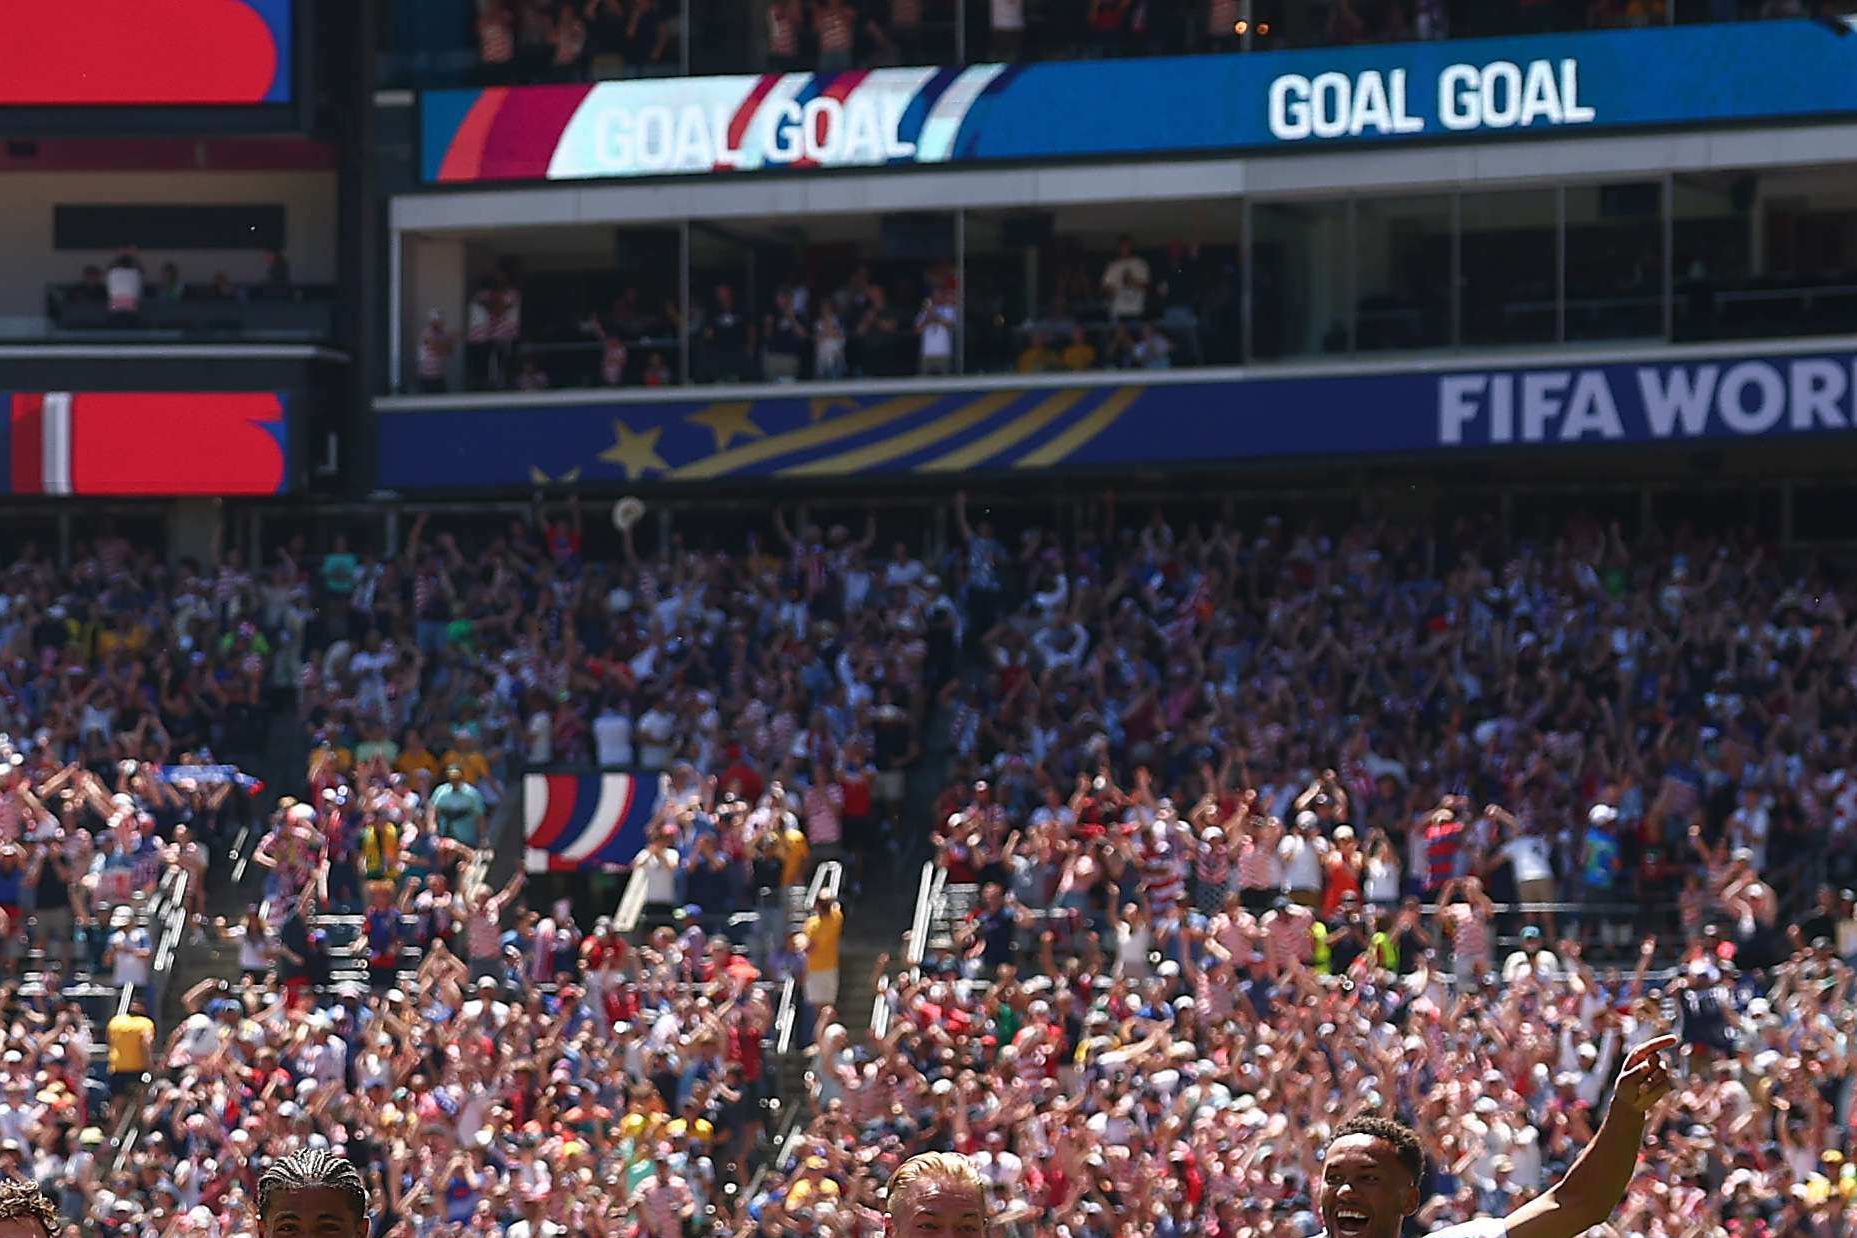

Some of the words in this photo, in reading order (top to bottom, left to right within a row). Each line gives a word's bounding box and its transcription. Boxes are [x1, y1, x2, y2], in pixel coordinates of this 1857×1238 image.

[595, 102, 741, 167] GOAL
[766, 95, 916, 162] GOAL
[1269, 68, 1425, 140] GOAL
[1438, 58, 1596, 131] GOAL
[1438, 369, 1626, 444] FIFA
[1636, 357, 1857, 436] WOR
